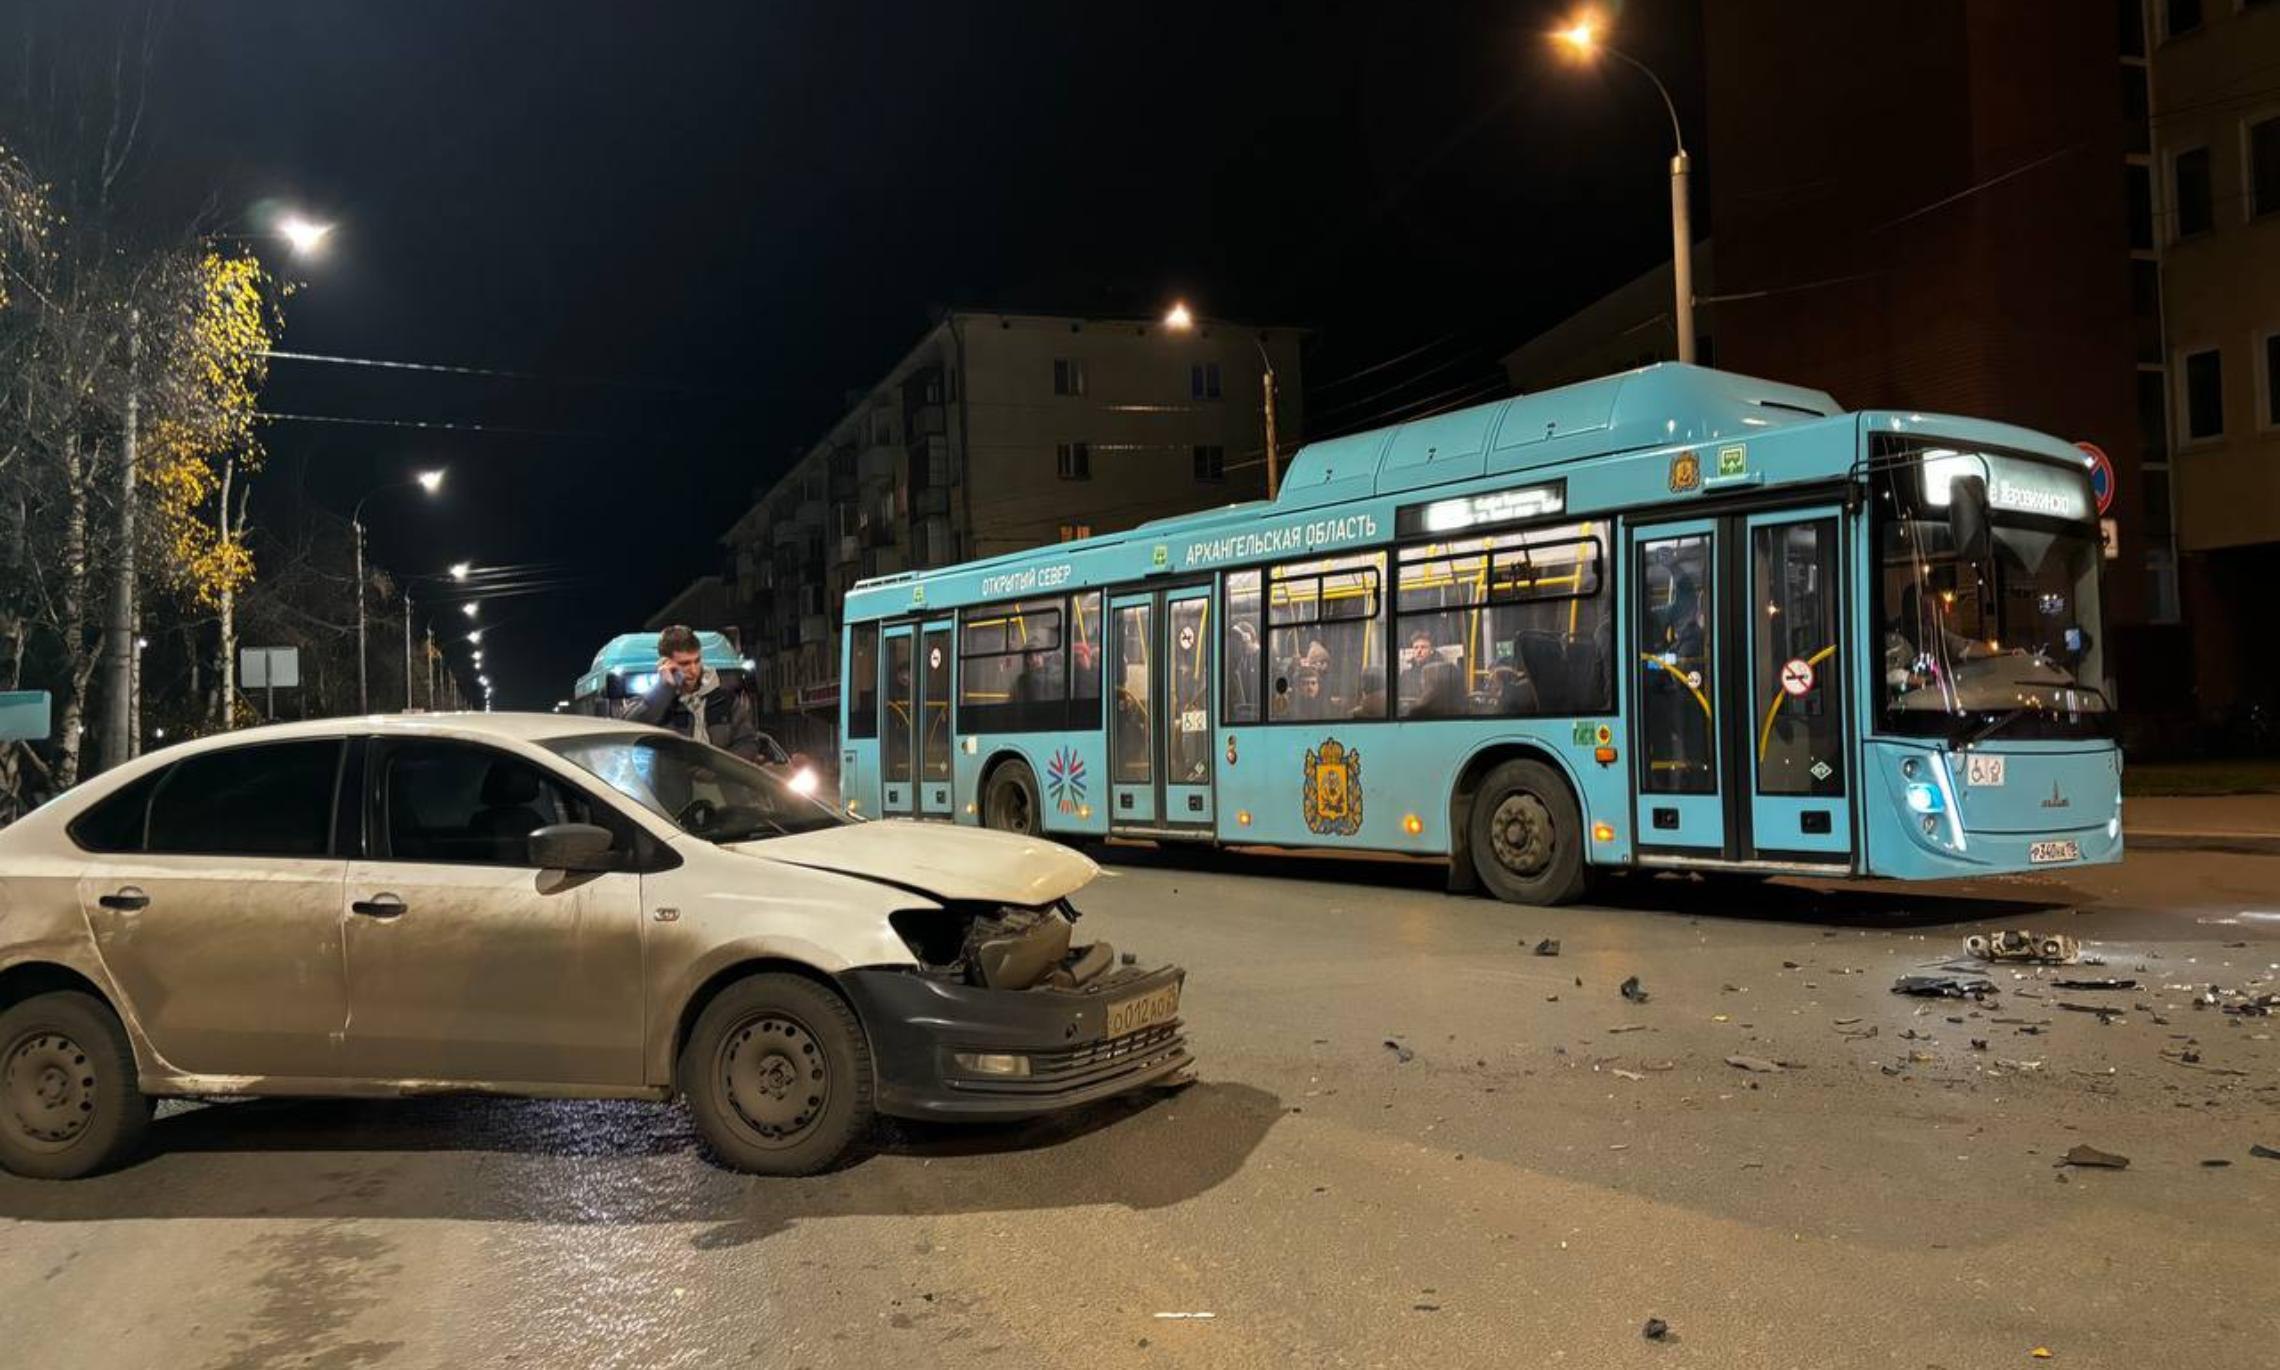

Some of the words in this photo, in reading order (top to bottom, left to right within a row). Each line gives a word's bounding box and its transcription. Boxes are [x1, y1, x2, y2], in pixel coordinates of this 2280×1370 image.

[1185, 527, 1301, 566] АРХАНГЕЛЬСКАЯ
[1305, 514, 1377, 546] ОБЛАСТЬ
[982, 567, 1036, 597] ОТКРЫТЫЙ
[1038, 564, 1071, 587] СЕВЕР
